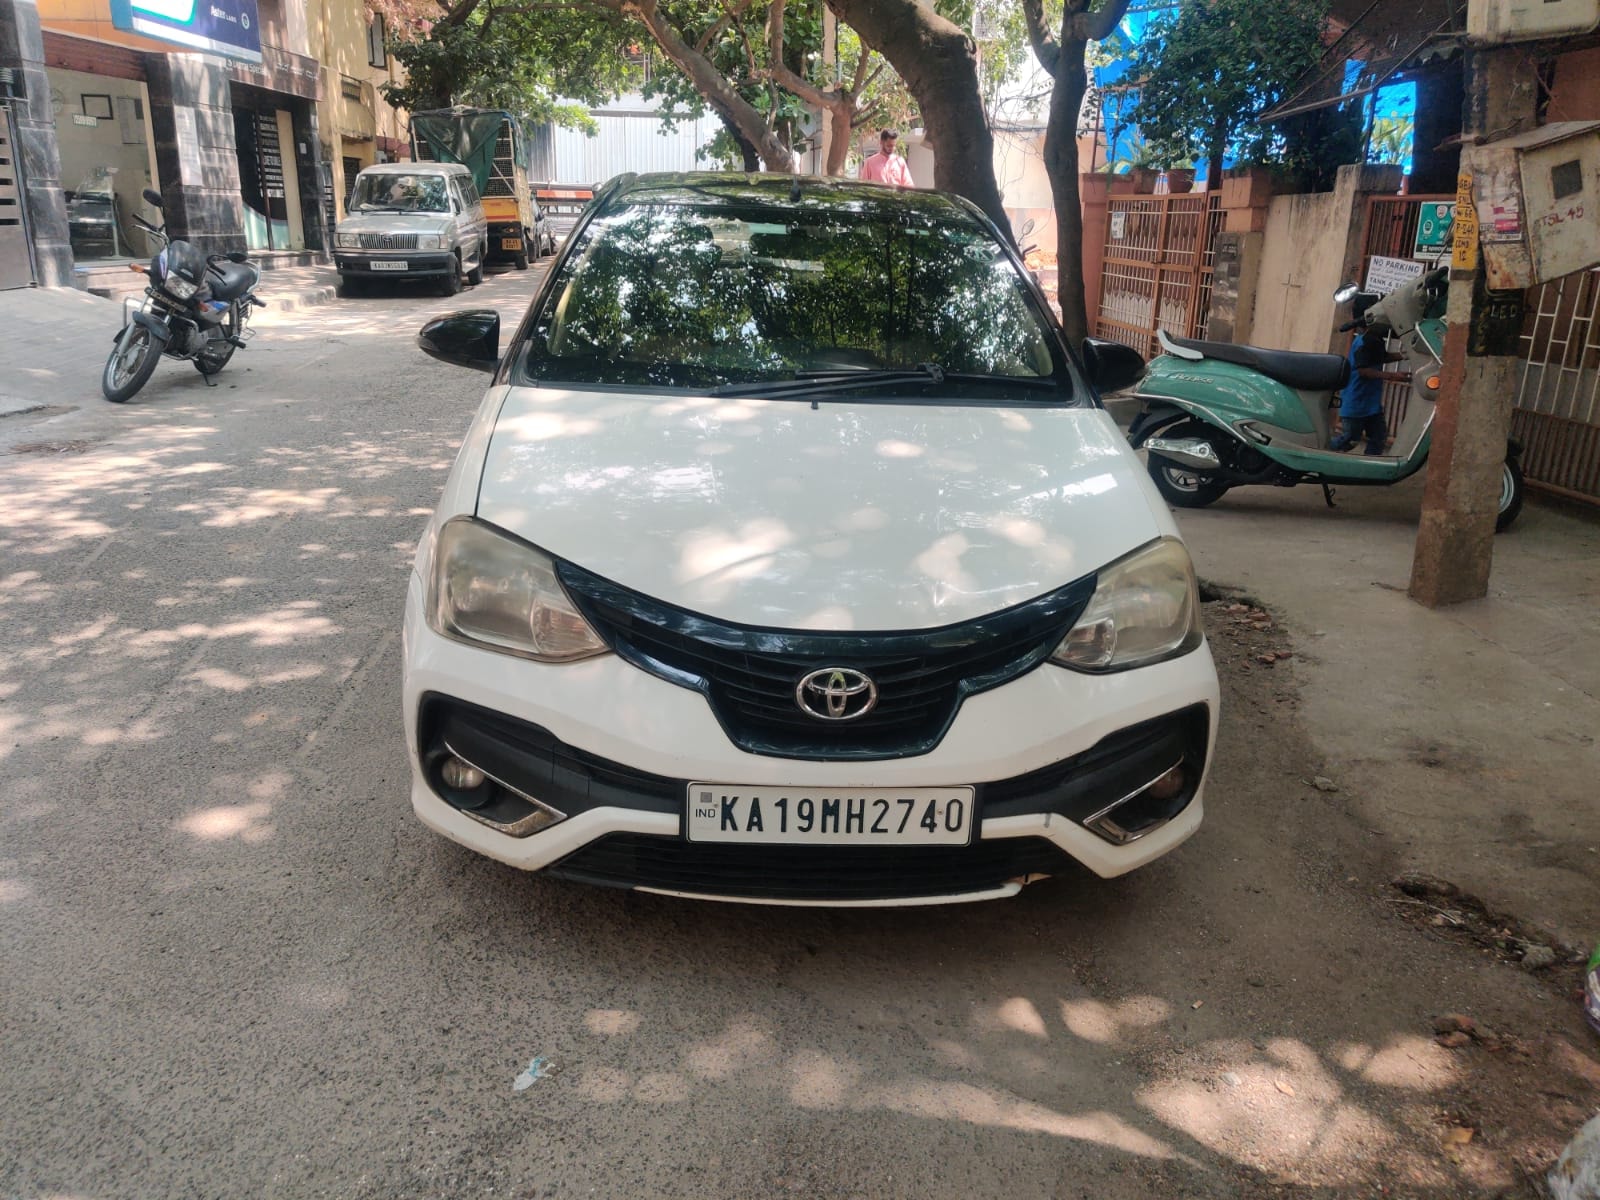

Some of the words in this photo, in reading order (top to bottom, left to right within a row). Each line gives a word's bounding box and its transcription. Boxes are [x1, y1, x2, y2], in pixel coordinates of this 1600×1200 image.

[1373, 257, 1384, 267] NO
[1385, 260, 1420, 274] PARKING
[694, 807, 716, 819] IND
[720, 795, 964, 834] KA19MH2740
